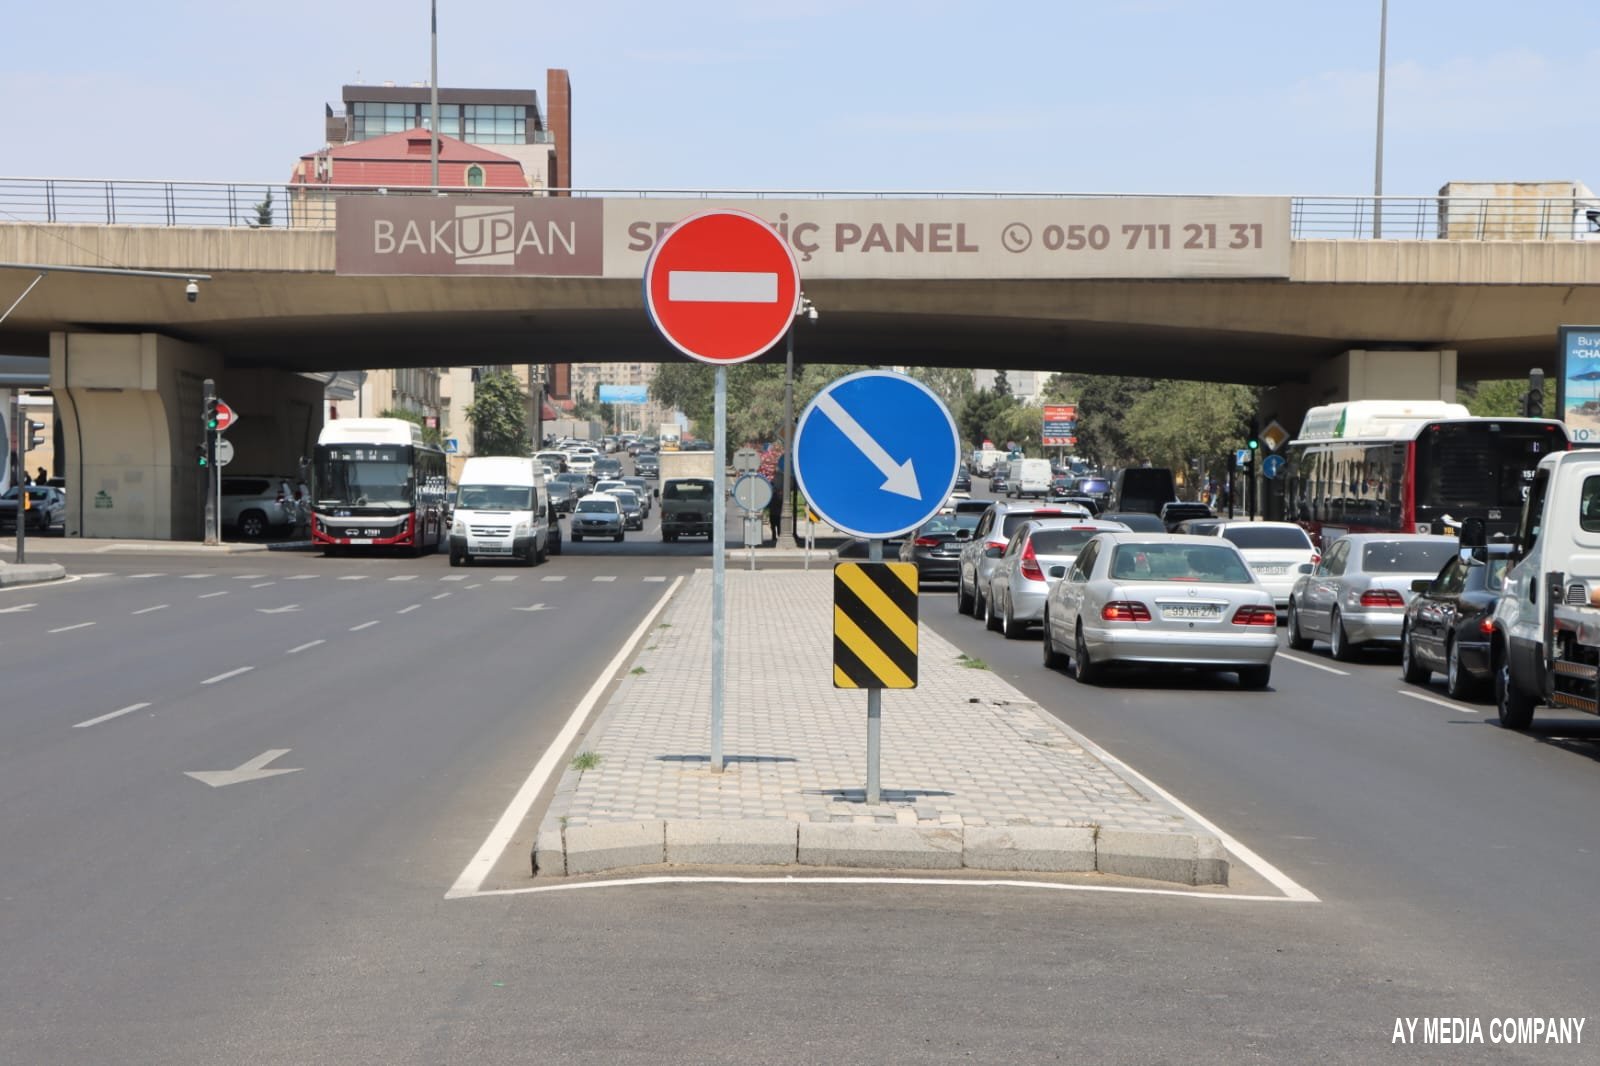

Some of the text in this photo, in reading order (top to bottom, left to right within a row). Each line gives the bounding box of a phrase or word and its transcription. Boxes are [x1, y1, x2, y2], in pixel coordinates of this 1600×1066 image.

[373, 219, 576, 255] BAKUPAN
[835, 222, 979, 253] PANEL
[1042, 222, 1263, 251] 050 711 21 31
